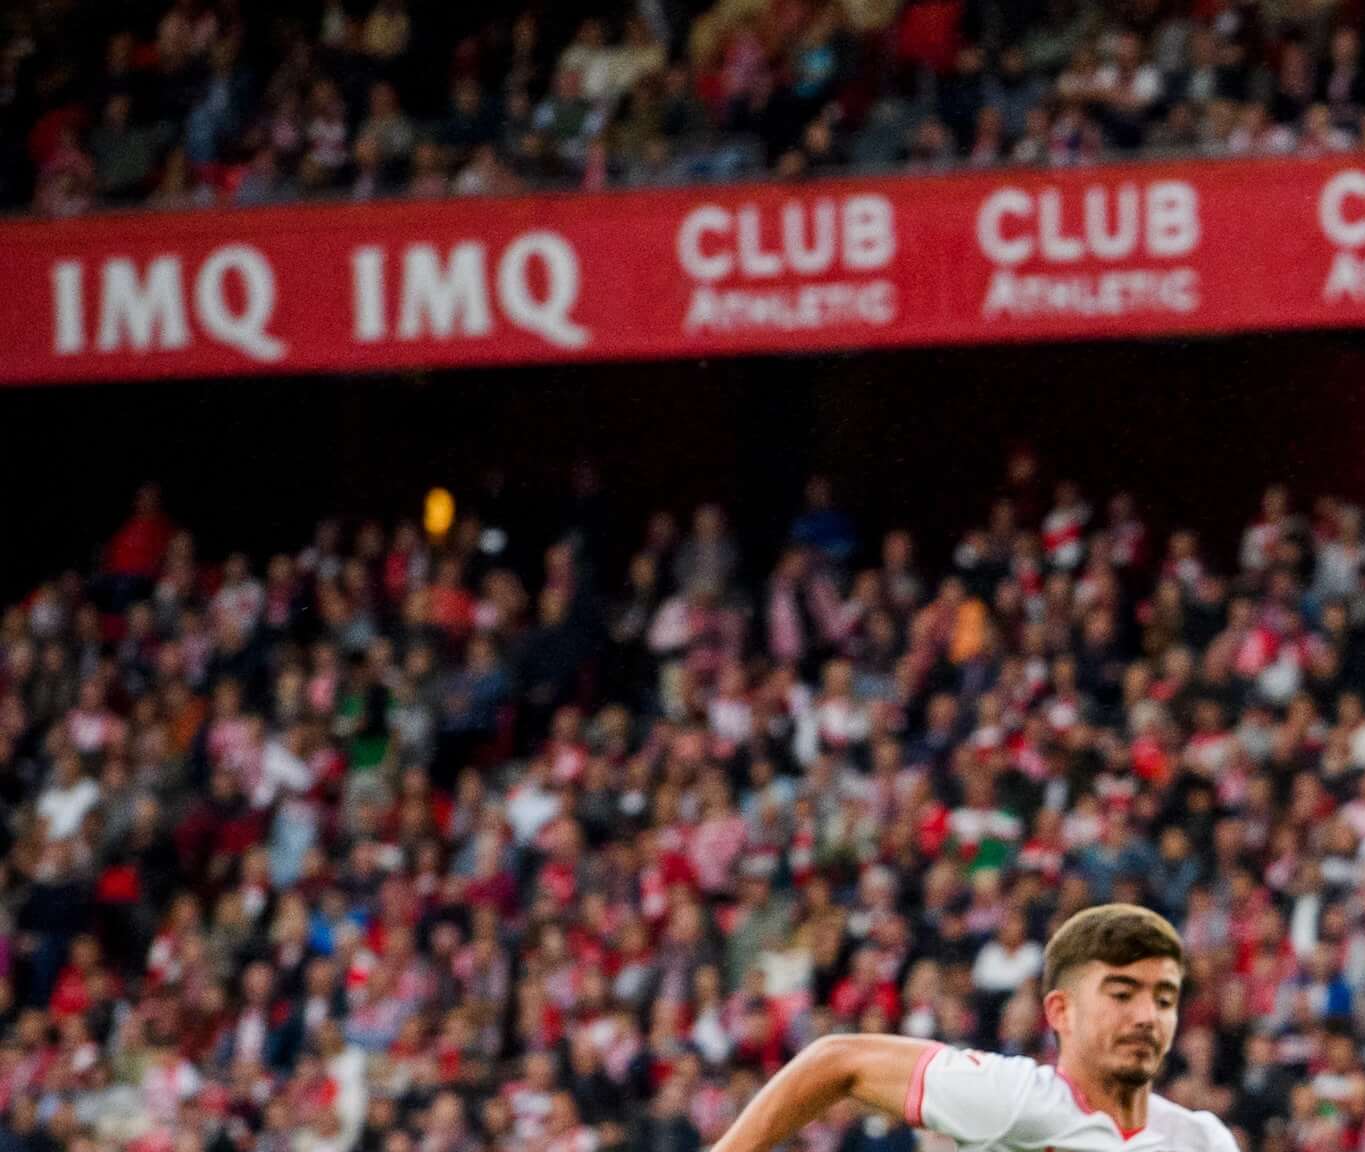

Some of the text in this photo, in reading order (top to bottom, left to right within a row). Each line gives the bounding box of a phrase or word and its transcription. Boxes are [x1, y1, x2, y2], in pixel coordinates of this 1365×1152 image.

[677, 194, 896, 279] CLUB
[976, 180, 1200, 263] CLUB
[53, 244, 288, 361] IMQ
[352, 231, 592, 349] IMQ
[685, 281, 895, 334] ATHLETIC
[983, 266, 1200, 319] ATHLETIC
